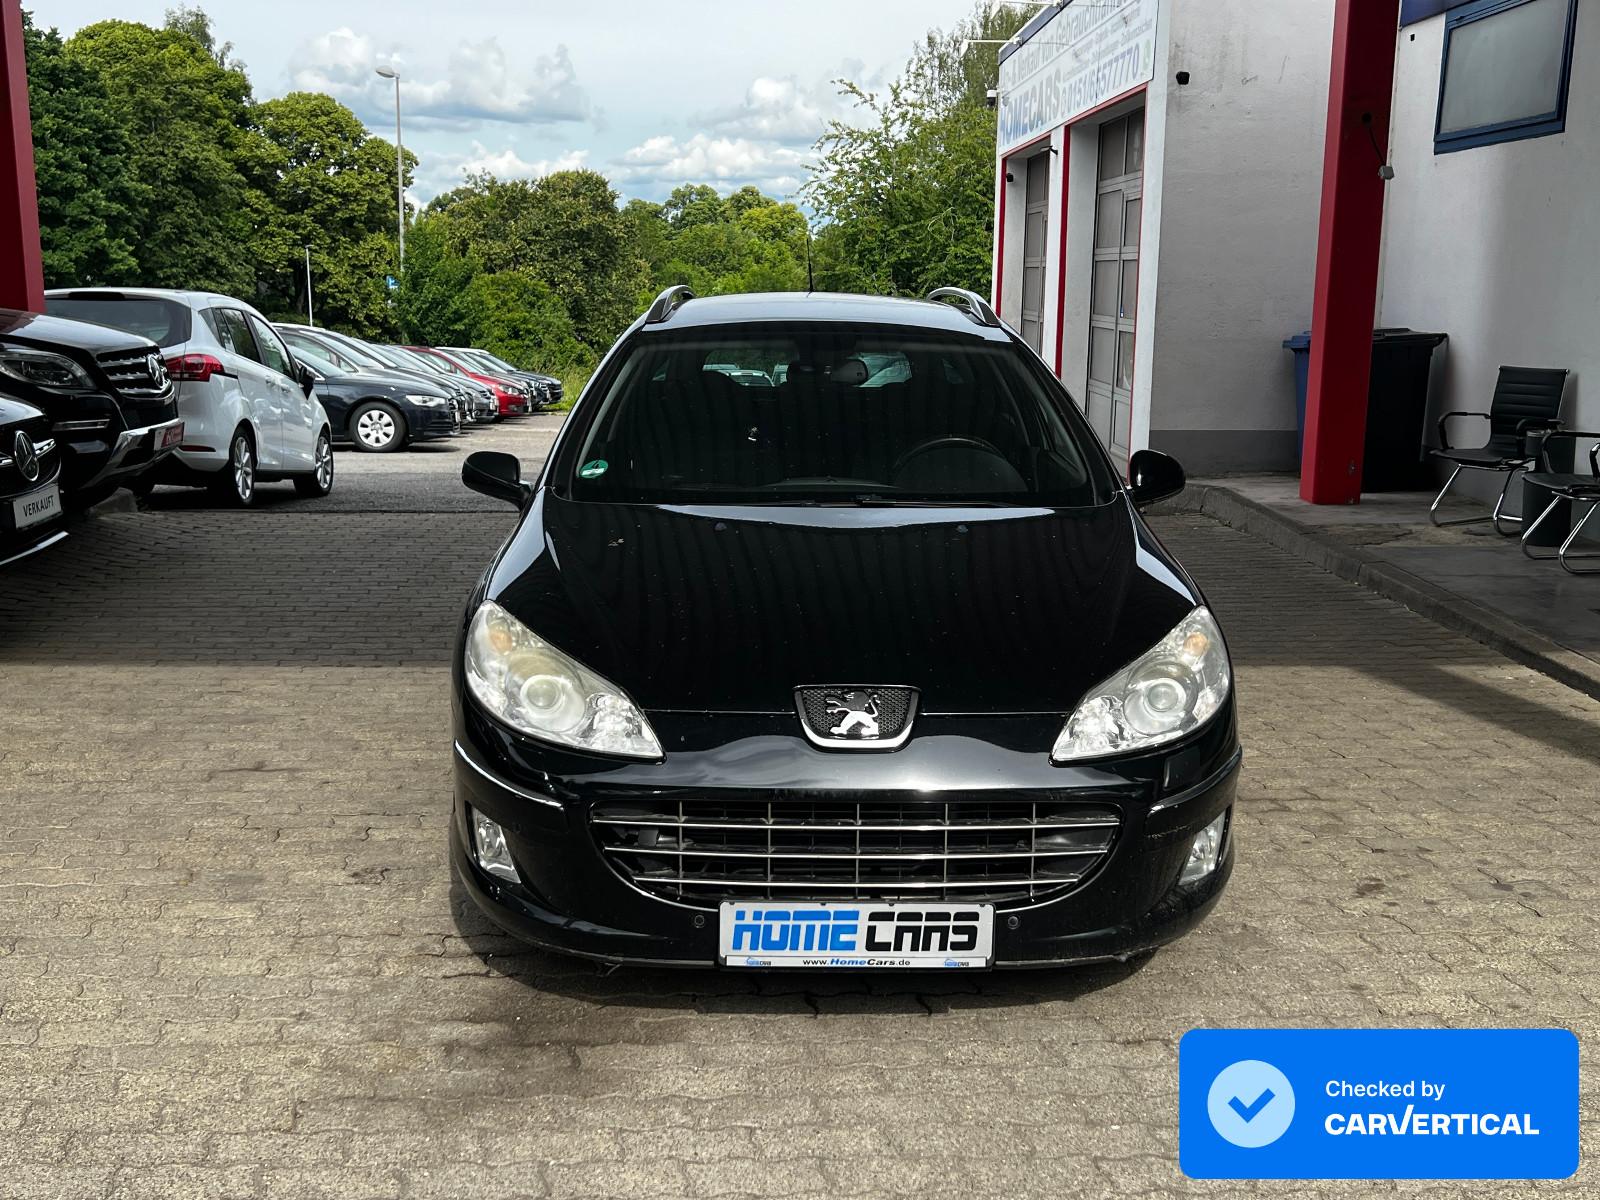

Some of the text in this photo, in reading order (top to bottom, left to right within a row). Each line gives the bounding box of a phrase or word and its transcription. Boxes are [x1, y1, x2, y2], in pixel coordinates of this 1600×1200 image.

[23, 494, 54, 517] VERKAUFT
[732, 910, 980, 952] HOME CARS
[803, 958, 910, 967] www.HomeCars.de
